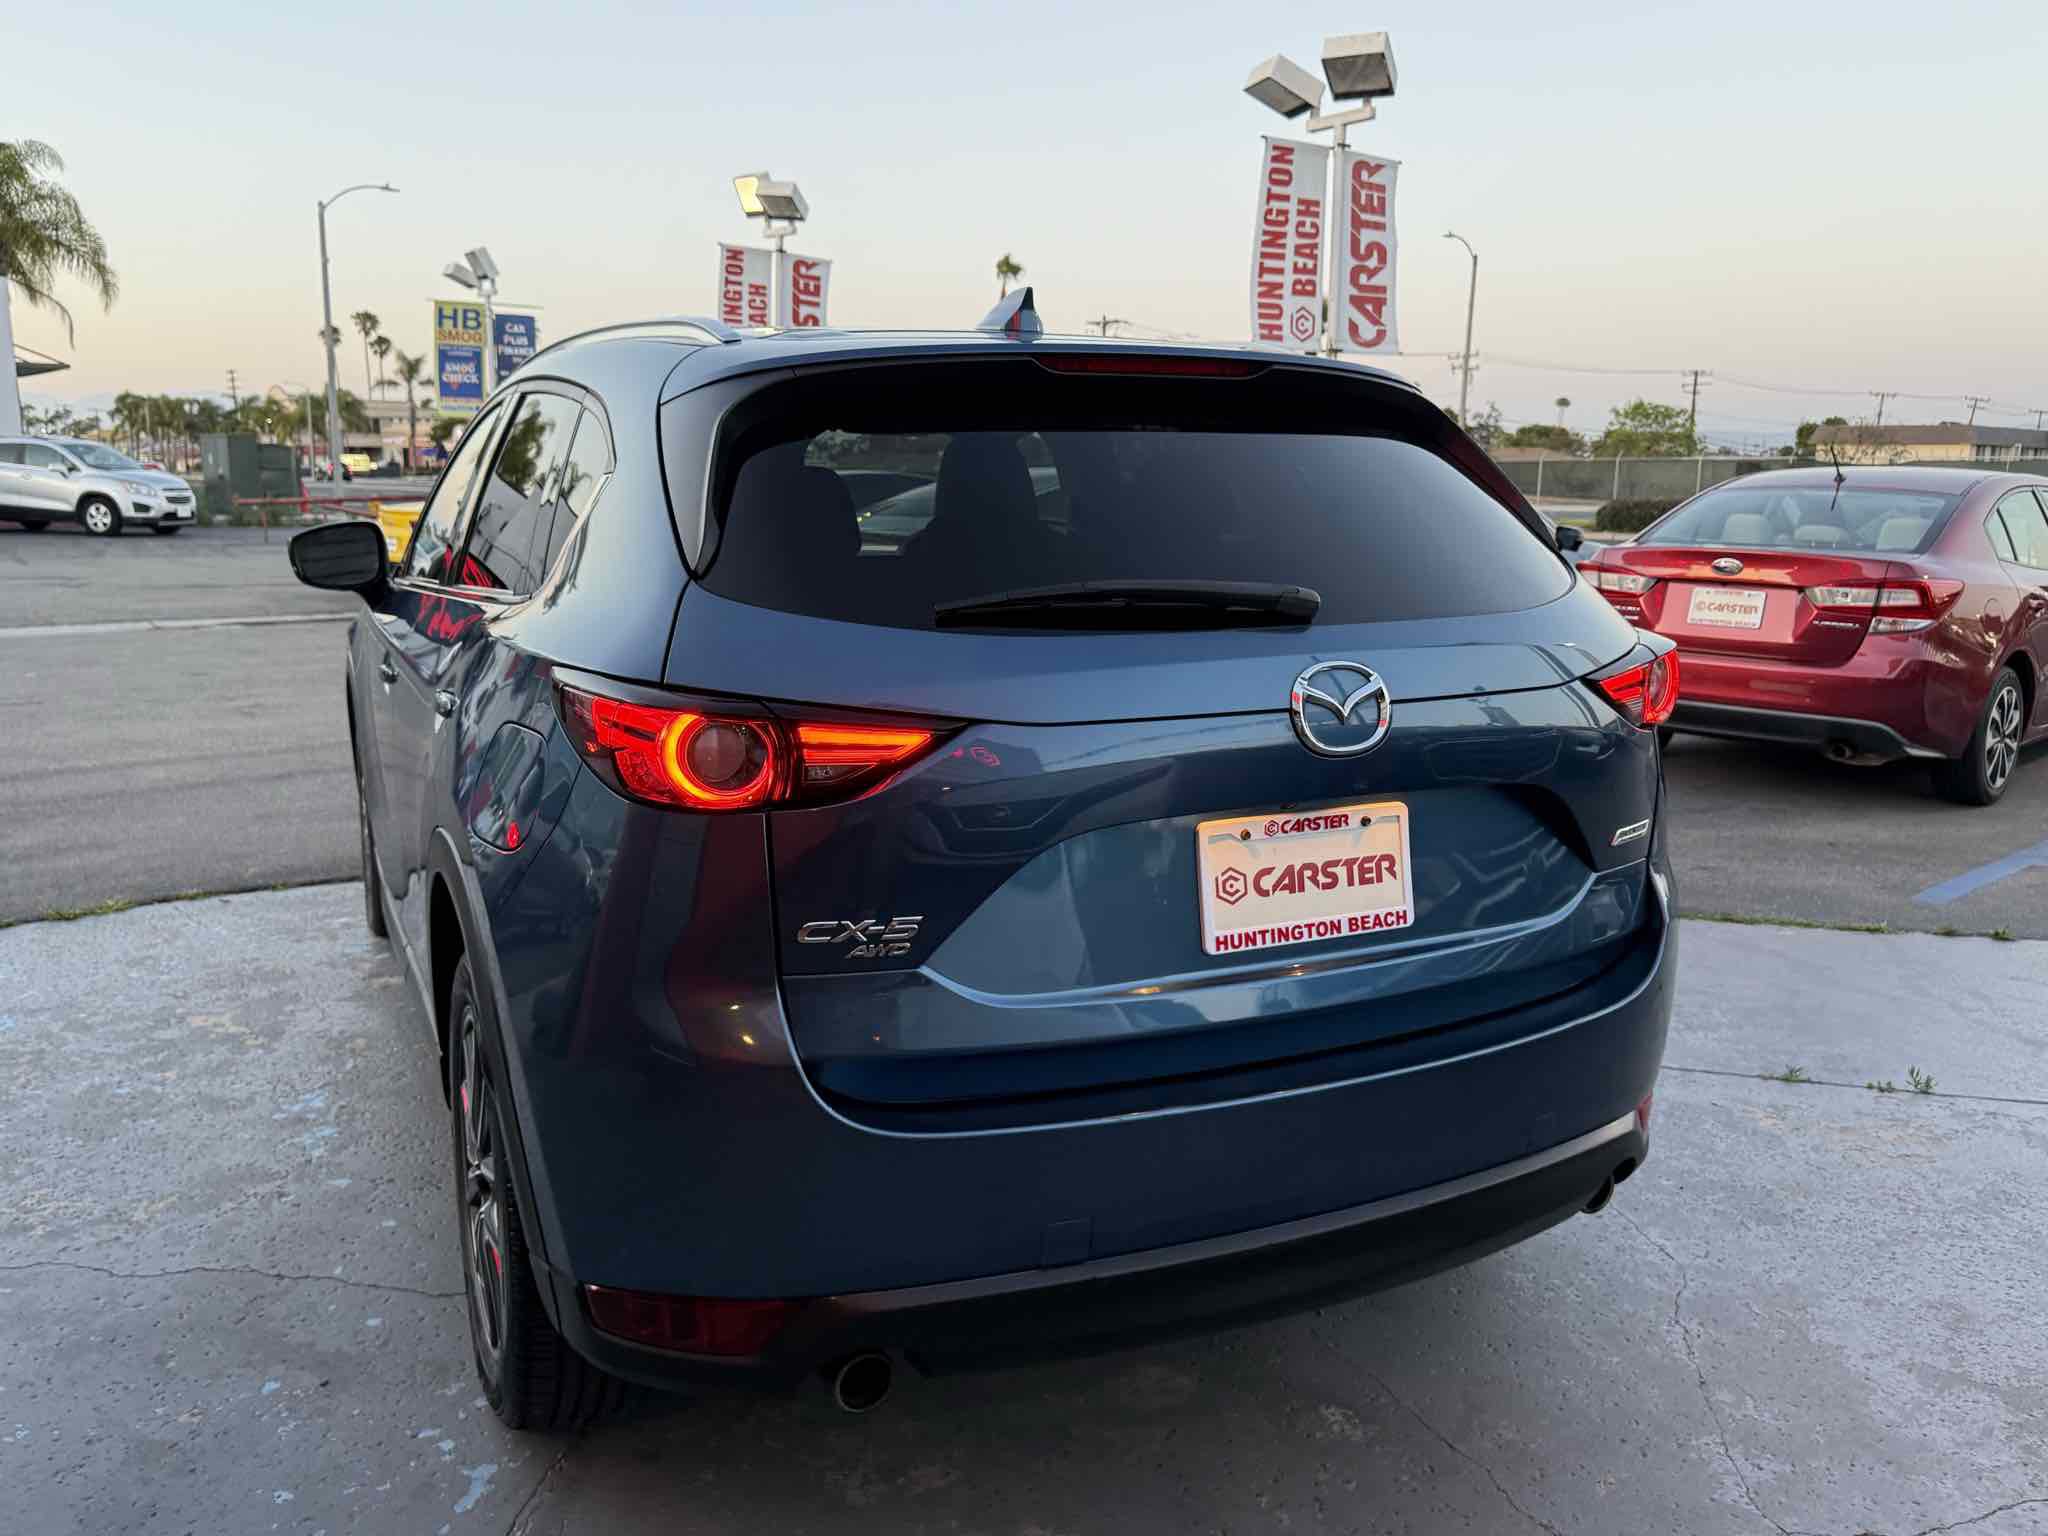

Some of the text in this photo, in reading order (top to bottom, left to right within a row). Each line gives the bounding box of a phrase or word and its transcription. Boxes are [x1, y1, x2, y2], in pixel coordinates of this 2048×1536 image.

[1257, 144, 1295, 342] HUNTINGTON
[1291, 197, 1321, 298] BEACH
[1348, 159, 1388, 348] CARSTER
[723, 248, 744, 325] INGTON
[748, 283, 767, 326] ACH
[792, 259, 821, 327] STER
[436, 329, 484, 343] SMOG
[438, 306, 482, 330] HB
[505, 322, 527, 333] CAR
[503, 334, 529, 346] PLUS
[441, 374, 480, 385] CHECK
[1280, 813, 1349, 834] CARSTER
[1252, 853, 1398, 898] CARSTER
[797, 915, 924, 943] CX-5
[1215, 910, 1408, 952] HUNTINGTON BEACH
